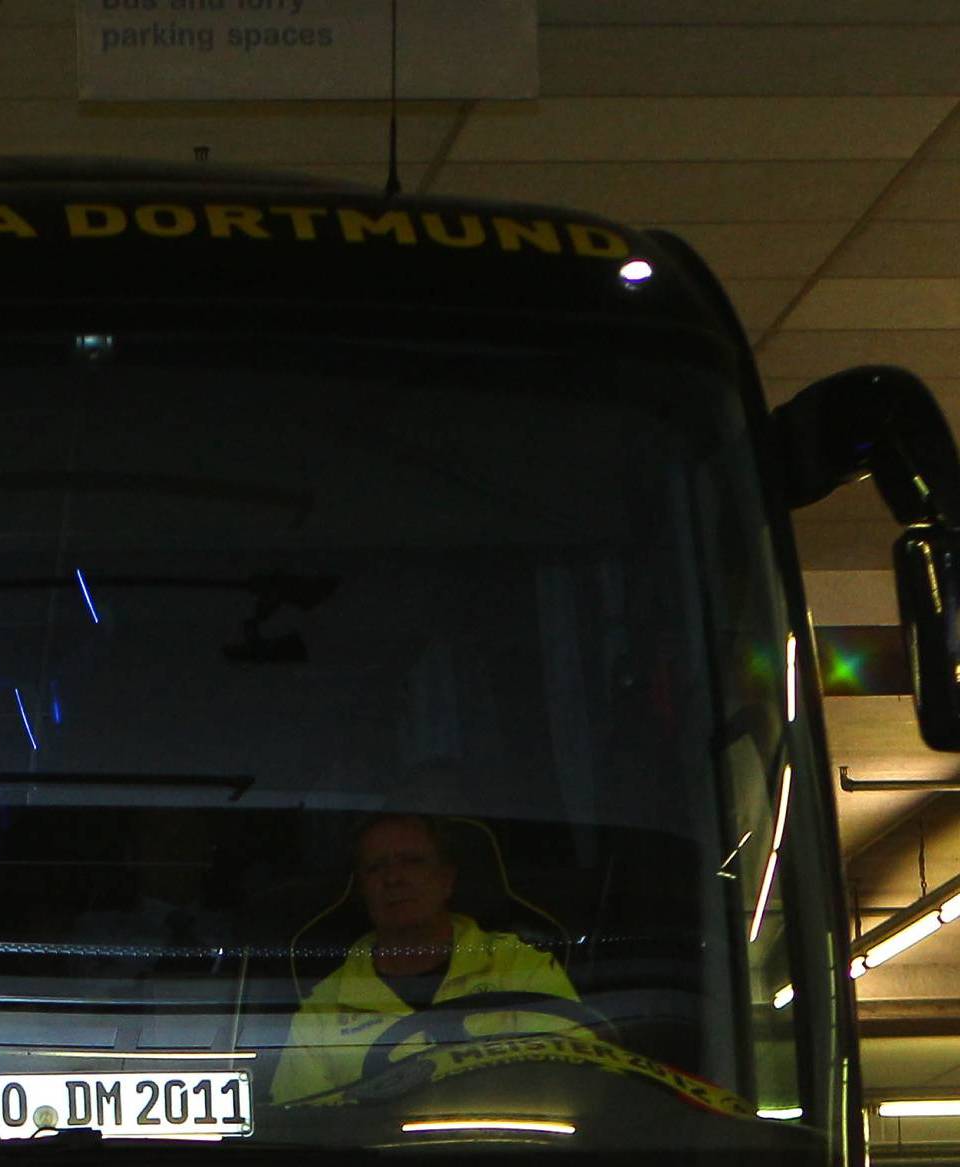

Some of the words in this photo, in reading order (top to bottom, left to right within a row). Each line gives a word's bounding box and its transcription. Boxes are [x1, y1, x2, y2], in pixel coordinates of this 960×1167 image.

[101, 21, 215, 52] parking
[227, 26, 334, 53] spaces
[62, 202, 632, 260] DORTMUND
[64, 1080, 123, 1127] DM
[135, 1078, 247, 1126] 2011
